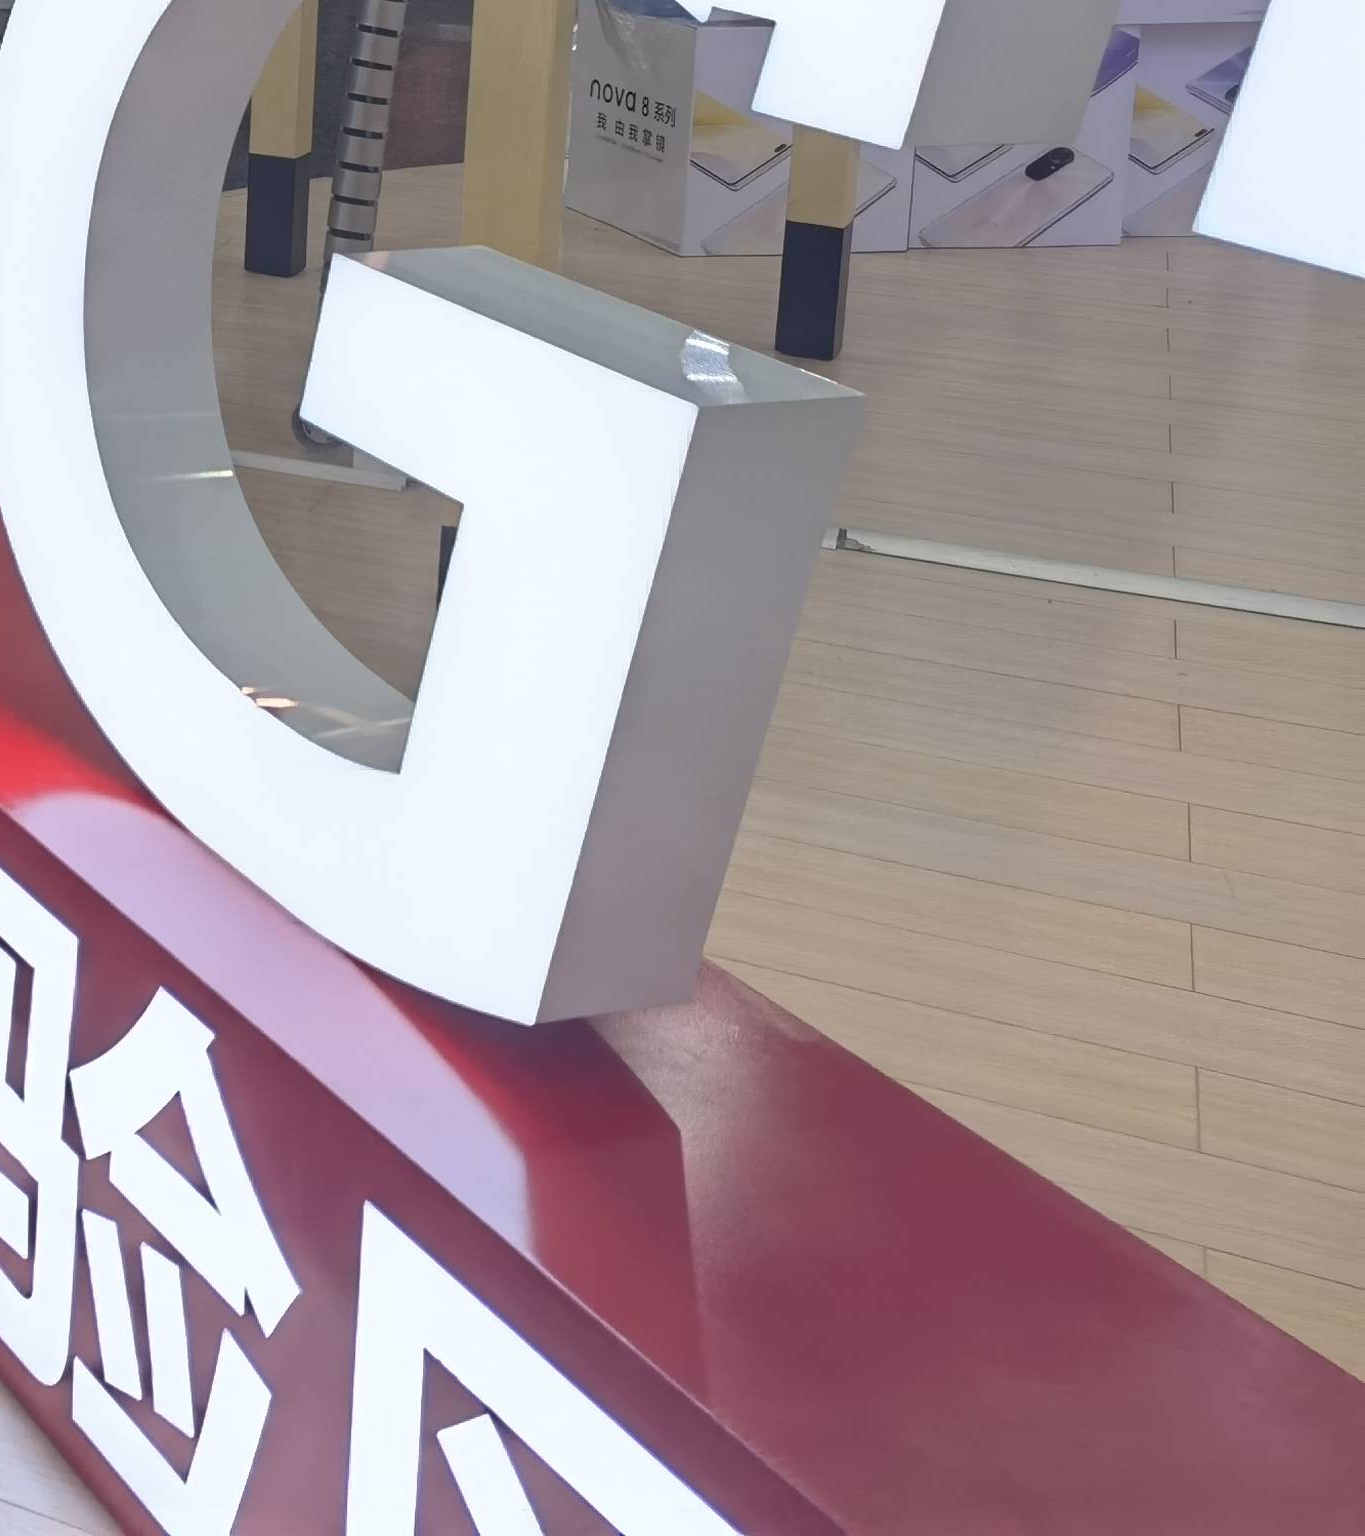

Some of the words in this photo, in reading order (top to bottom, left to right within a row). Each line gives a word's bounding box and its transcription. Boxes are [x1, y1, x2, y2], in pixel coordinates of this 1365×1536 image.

[590, 78, 637, 113] nova
[641, 96, 649, 117] 8
[654, 101, 677, 128] 系列
